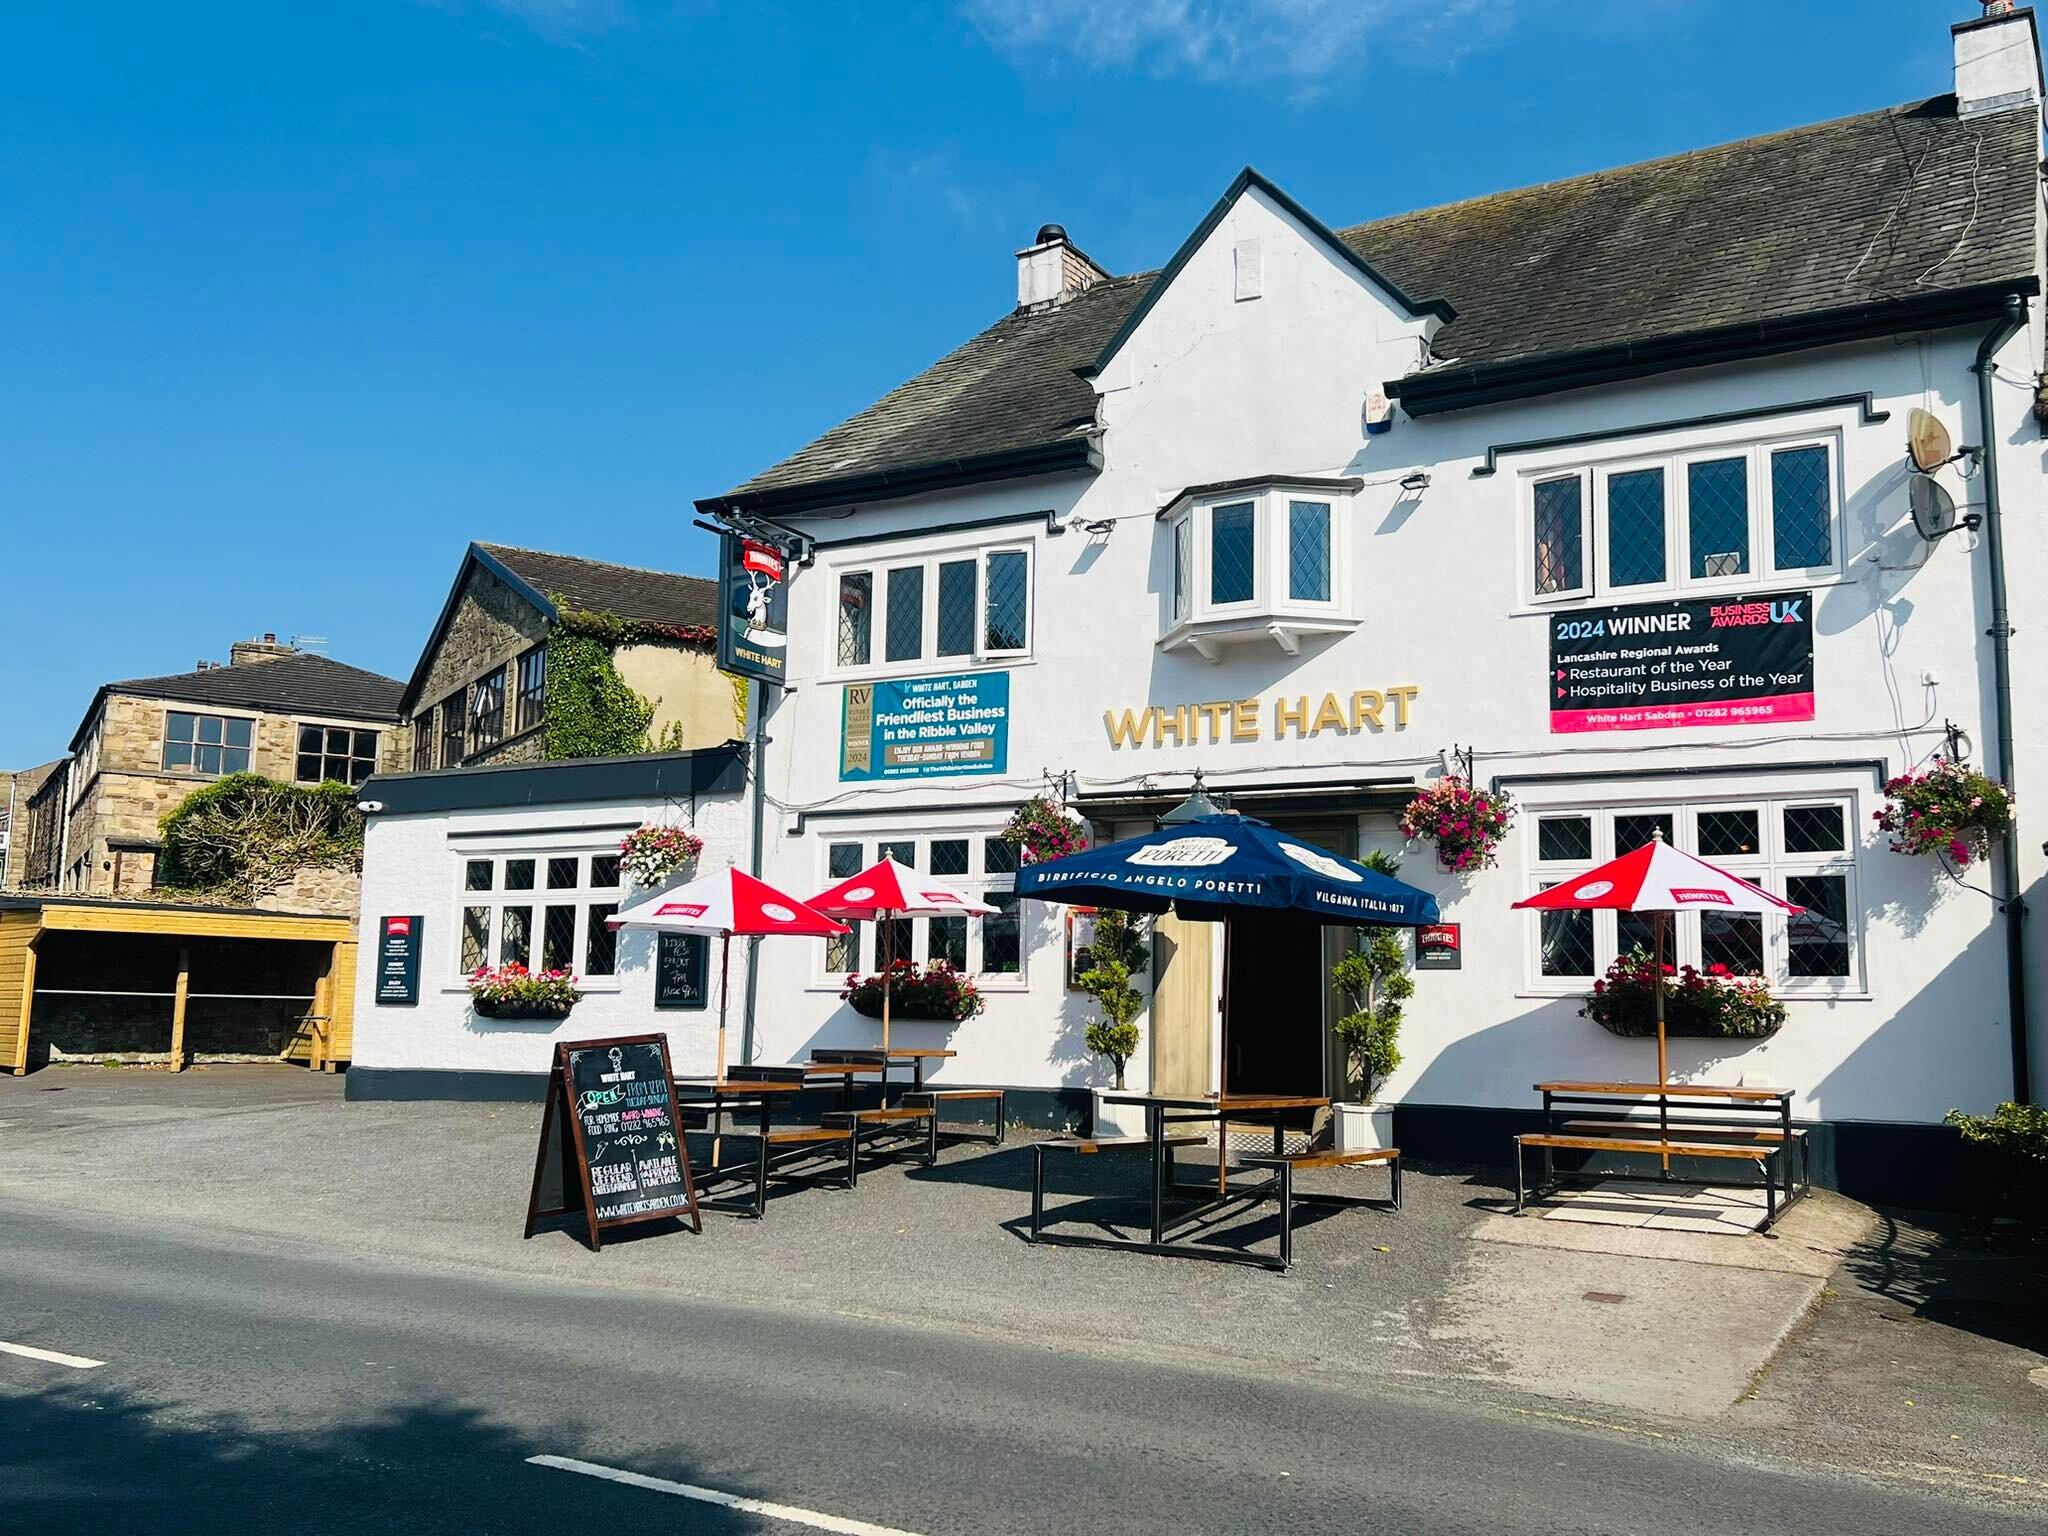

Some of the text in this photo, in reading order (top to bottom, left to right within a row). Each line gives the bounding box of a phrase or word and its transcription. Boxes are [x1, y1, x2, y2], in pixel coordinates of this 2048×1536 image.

[1710, 600, 1803, 624] BUSINESS UK
[1557, 613, 1691, 640] 2024 WINNER
[1711, 613, 1769, 628] AWARDS
[735, 646, 782, 669] WHITE HART
[1557, 643, 1719, 663] Lancashire Regional Awards
[1570, 659, 1732, 680] Restaurant of the Year
[912, 683, 932, 692] WHITE
[953, 679, 977, 689] SABDEN
[1570, 671, 1803, 700] Hospitality Business of the Year
[850, 688, 871, 704] RV
[902, 694, 977, 710] Officially the
[876, 707, 1005, 726] Friendliest Business
[1105, 686, 1419, 748] WHITE HART
[1587, 705, 1773, 723] White Hart Sabden 01282 965965
[884, 723, 995, 740] in the Ribble Valley
[924, 743, 969, 753] AWARD-WINNING
[970, 741, 985, 749] FOOD
[848, 753, 867, 762] 2024
[897, 752, 943, 762] TUESDAY-SUNDAY
[944, 751, 960, 760] FROM
[1139, 849, 1222, 861] PORETTI
[1038, 872, 1261, 894] BIRRIFICIO ANGELO PORETTI
[1677, 893, 1727, 902] THWAITES
[1360, 897, 1387, 912] ITALIA
[1389, 904, 1405, 914] 1877
[600, 1071, 636, 1083] WHITE HART
[626, 1081, 648, 1096] FROM
[587, 1089, 617, 1104] OPEN
[584, 1107, 664, 1126] FOR HOMEMADE AWARD-WINNING
[587, 1115, 670, 1135] FOOD RING 01282 965965
[591, 1162, 632, 1177] REGULAR
[639, 1156, 677, 1171] AVAILABLE
[592, 1172, 634, 1186] WEEKEND
[649, 1165, 679, 1178] PRIVATE
[592, 1180, 637, 1195] ENTERTAINMENT
[641, 1174, 681, 1188] FUNCTIONS
